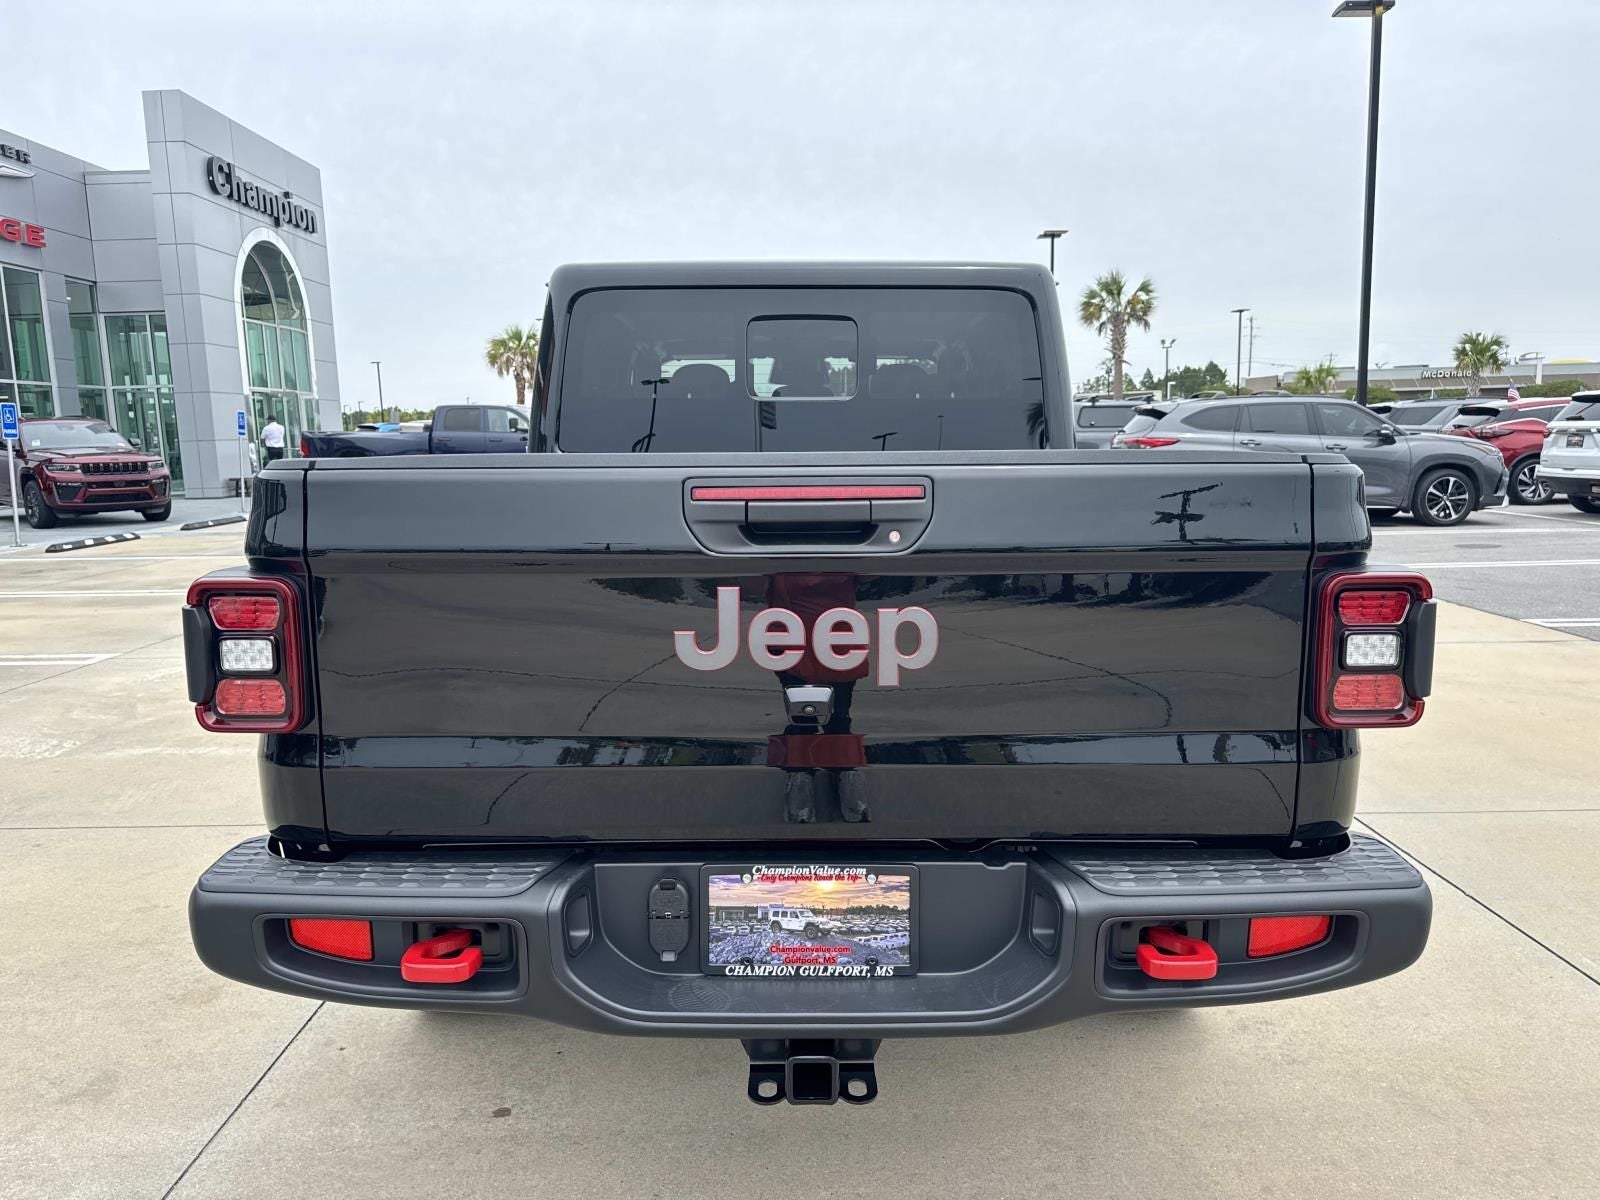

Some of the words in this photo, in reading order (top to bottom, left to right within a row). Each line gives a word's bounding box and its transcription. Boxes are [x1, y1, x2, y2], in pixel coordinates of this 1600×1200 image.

[206, 155, 318, 234] Champion
[673, 586, 940, 687] Jeep
[752, 865, 867, 876] ChampionValue.com
[770, 945, 851, 955] Championvalue.com
[823, 956, 837, 964] MS
[725, 965, 796, 976] CHAMPION
[800, 965, 871, 978] GULFPORT,
[874, 965, 895, 976] MS
